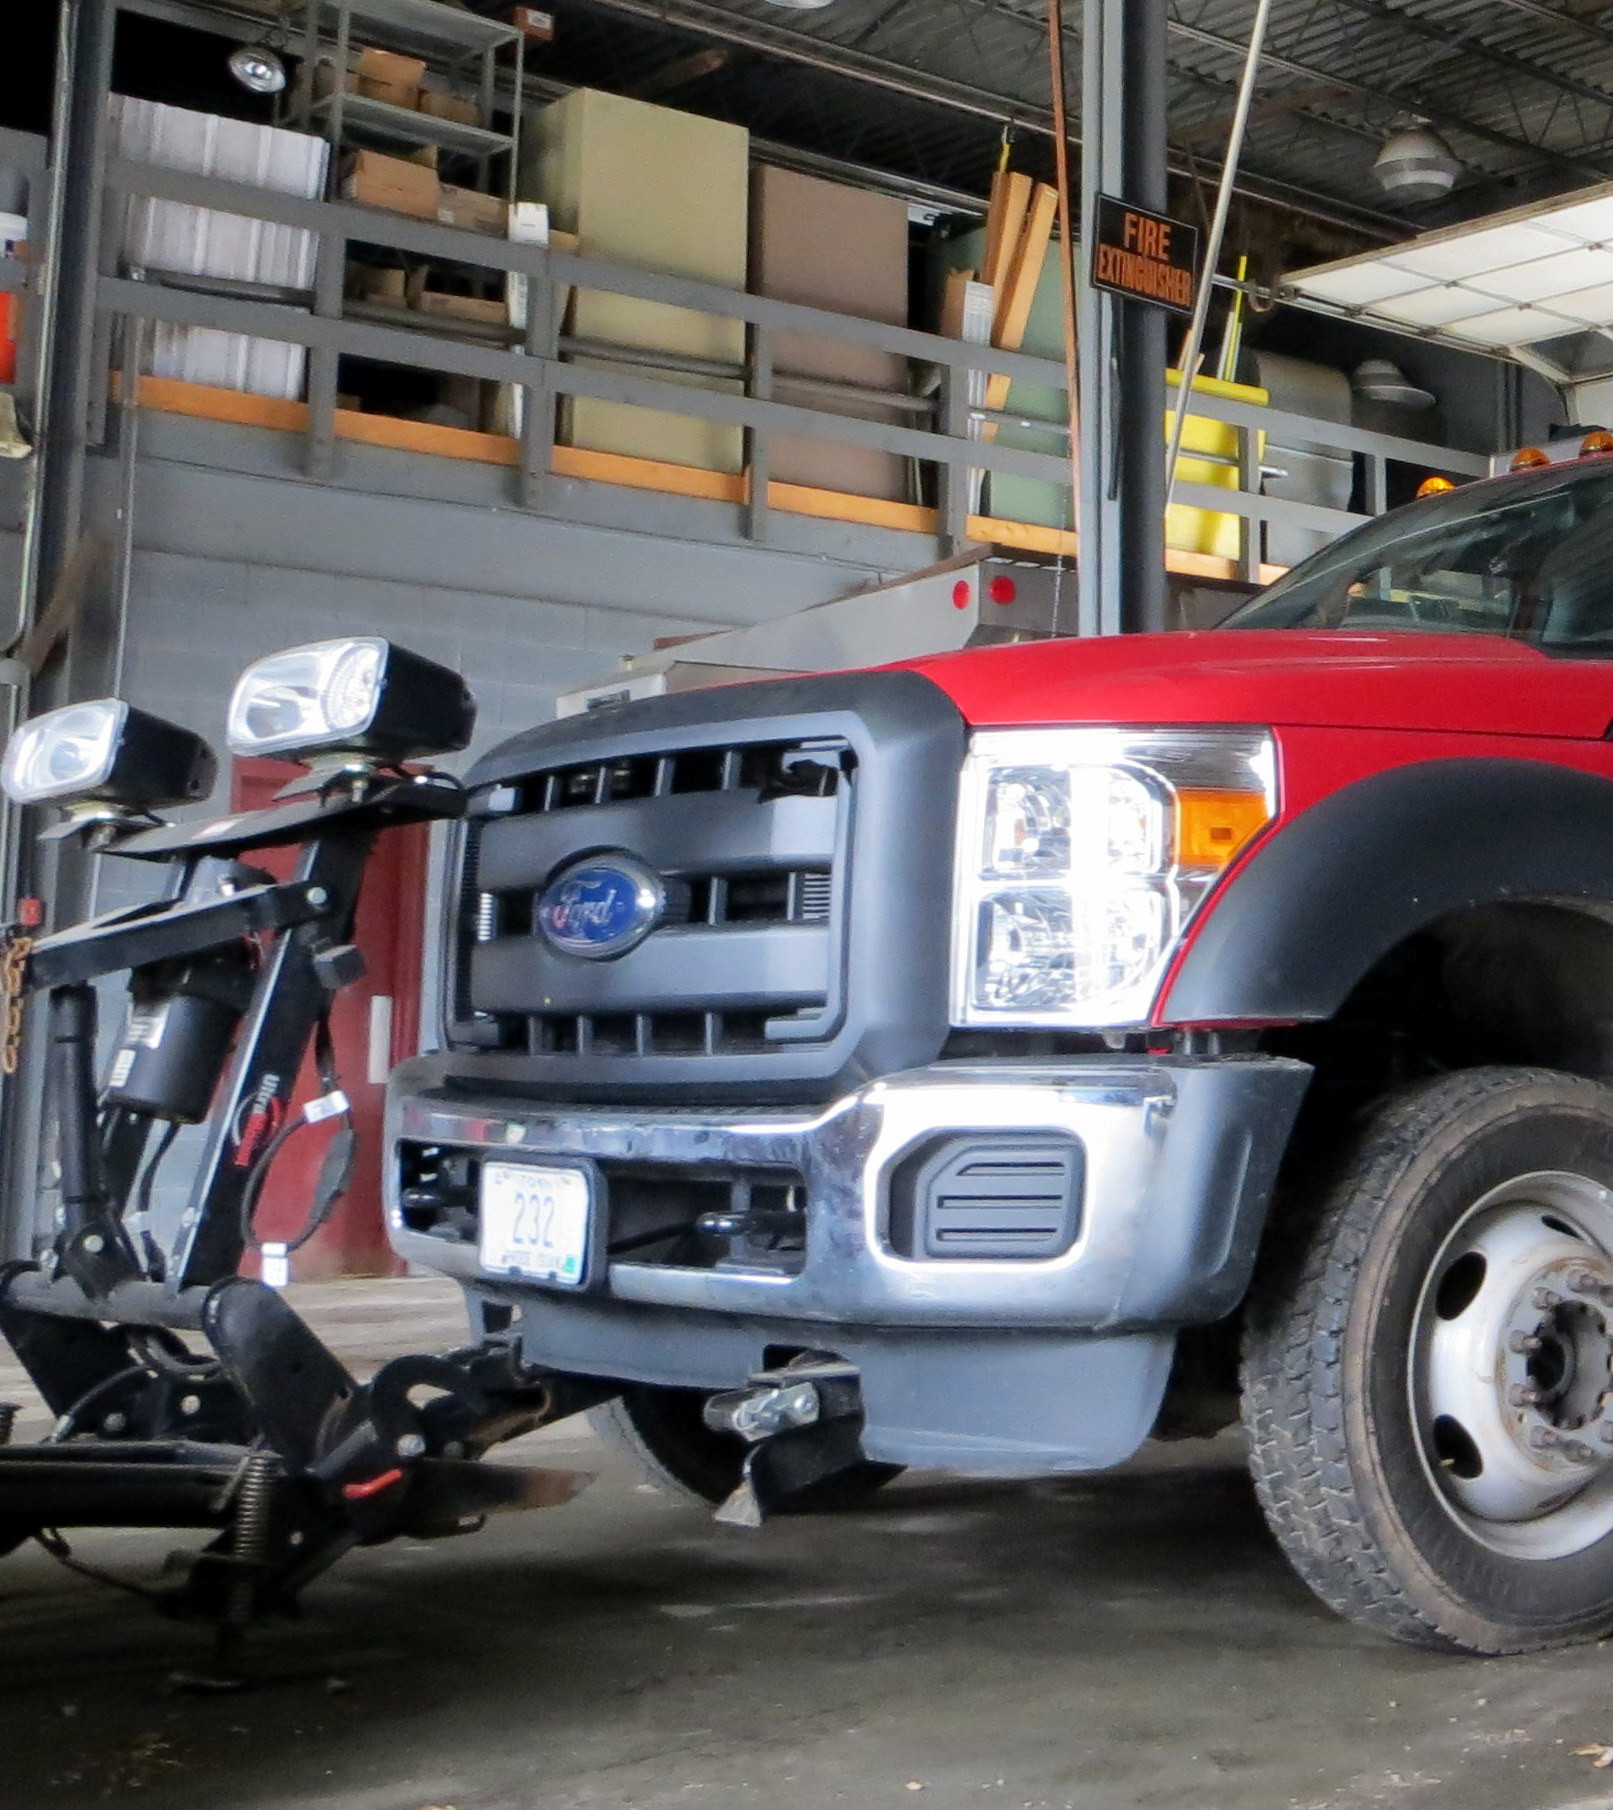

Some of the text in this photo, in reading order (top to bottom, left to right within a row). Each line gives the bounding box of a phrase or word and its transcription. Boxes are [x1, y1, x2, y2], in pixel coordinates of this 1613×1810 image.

[1123, 211, 1172, 261] FIRE
[1097, 243, 1193, 306] EXTINGUISHER
[512, 1192, 556, 1248] 232
